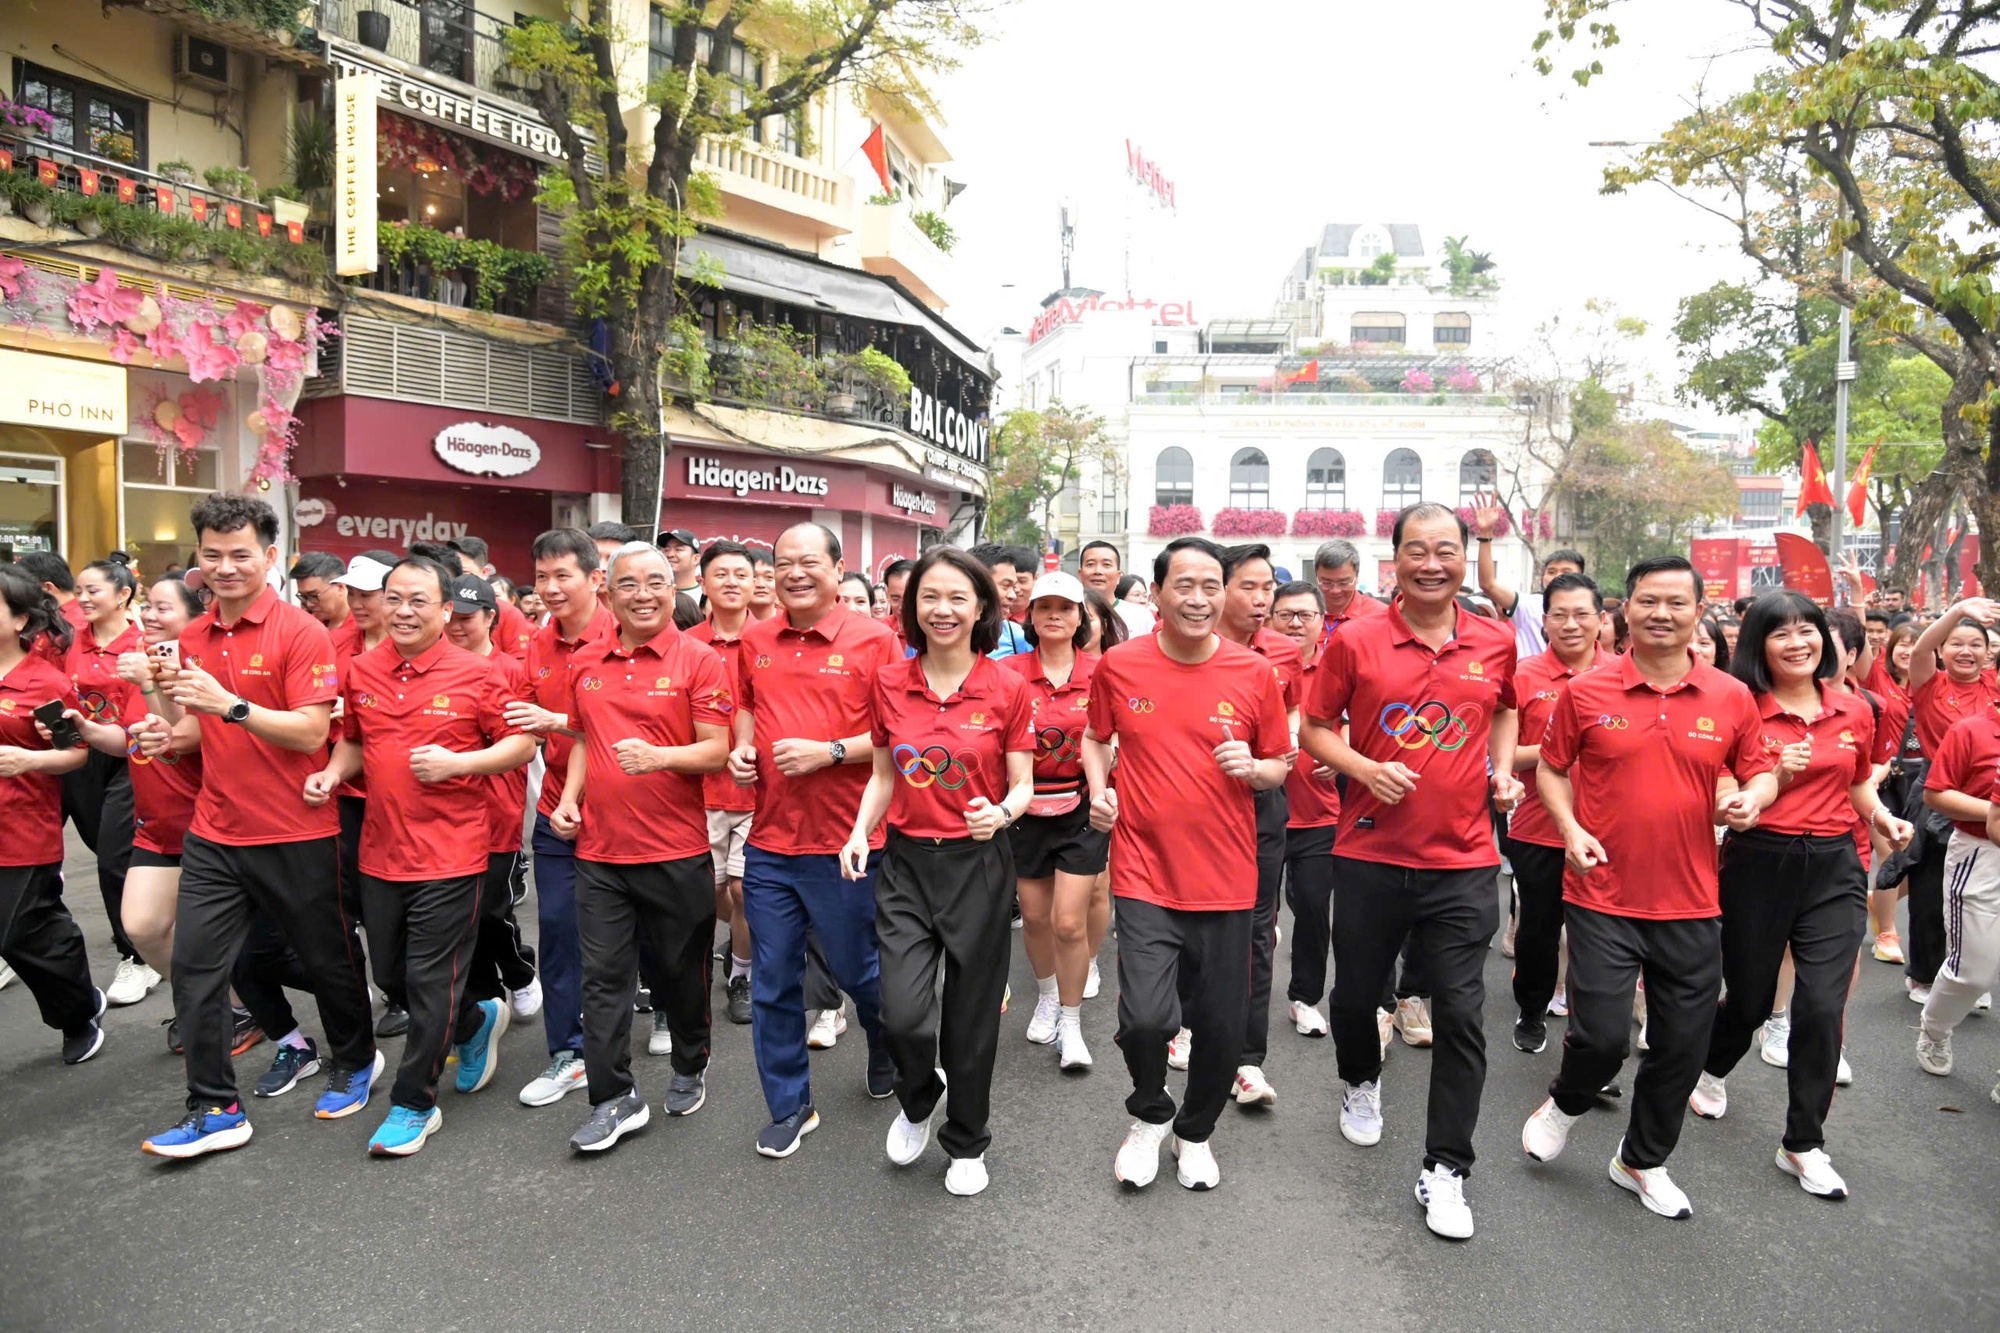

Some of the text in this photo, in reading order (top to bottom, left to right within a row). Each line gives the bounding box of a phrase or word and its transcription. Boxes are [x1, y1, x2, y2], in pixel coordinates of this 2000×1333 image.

[338, 60, 588, 168] TE COFFEE HOU
[347, 93, 356, 255] THE COFFEE HOUSE
[81, 405, 113, 421] INN
[910, 386, 988, 463] BALCONY
[0, 535, 14, 544] :00
[336, 512, 469, 548] everyday
